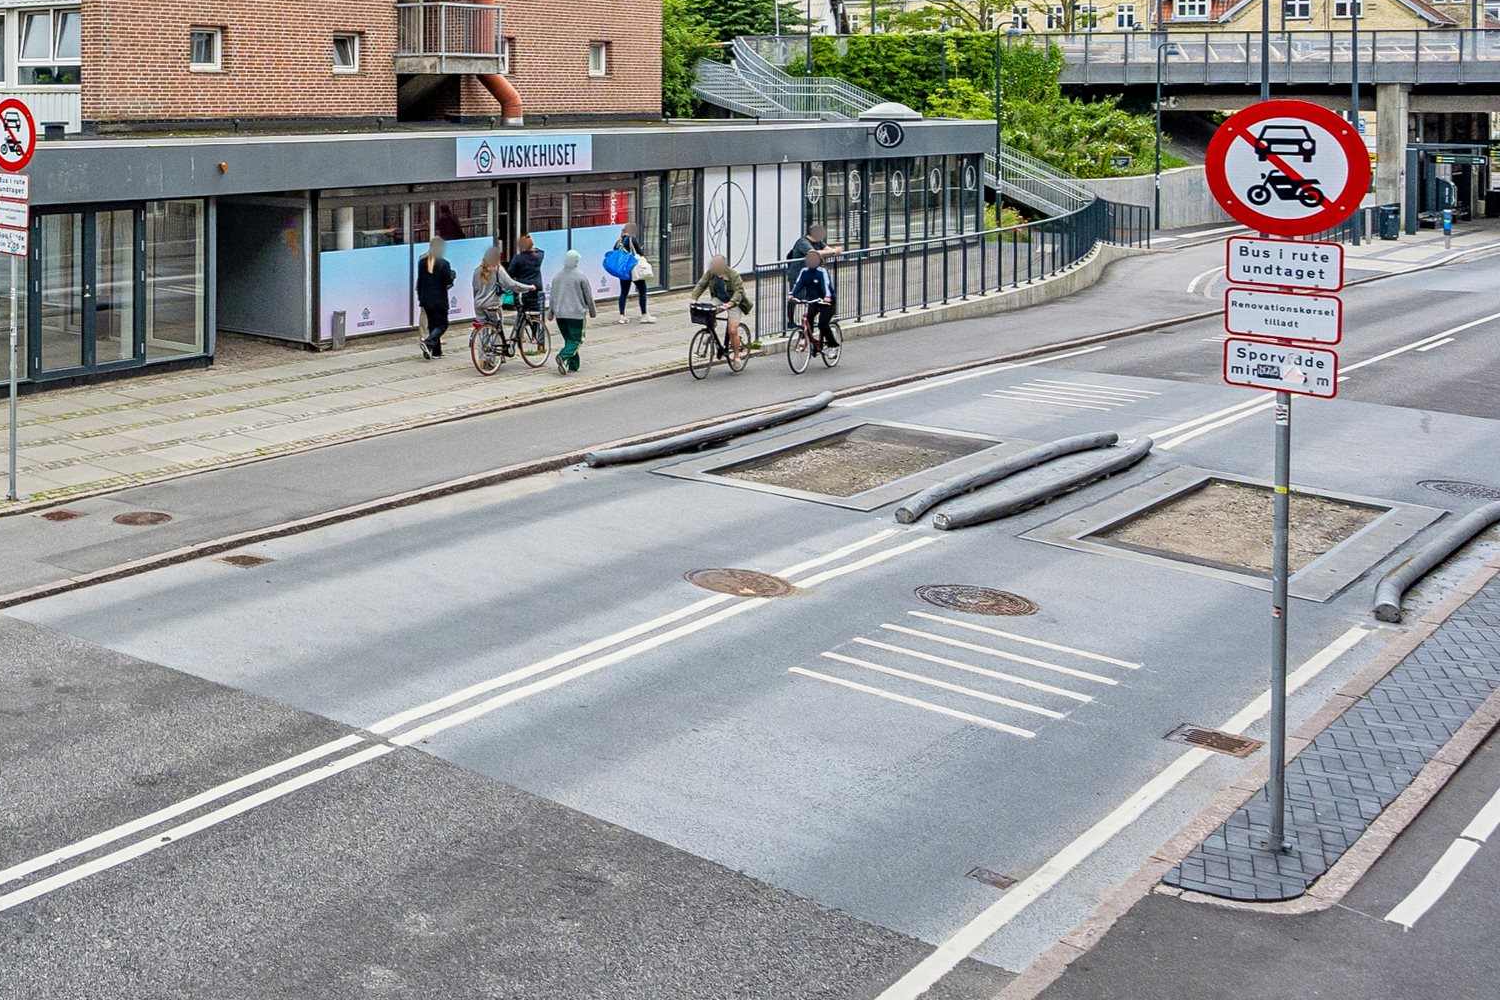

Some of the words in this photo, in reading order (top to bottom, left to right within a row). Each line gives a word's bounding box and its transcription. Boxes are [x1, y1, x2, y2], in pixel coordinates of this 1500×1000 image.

[500, 144, 576, 168] VASKEHUSET
[1239, 246, 1271, 259] Bus
[1279, 249, 1283, 259] i
[1292, 251, 1330, 263] rute
[1243, 264, 1325, 280] undtaget
[1231, 300, 1335, 317] Renovationskørsel
[1264, 318, 1299, 328] tilladt
[1236, 347, 1325, 369] Sporvdde
[1316, 377, 1329, 387] m
